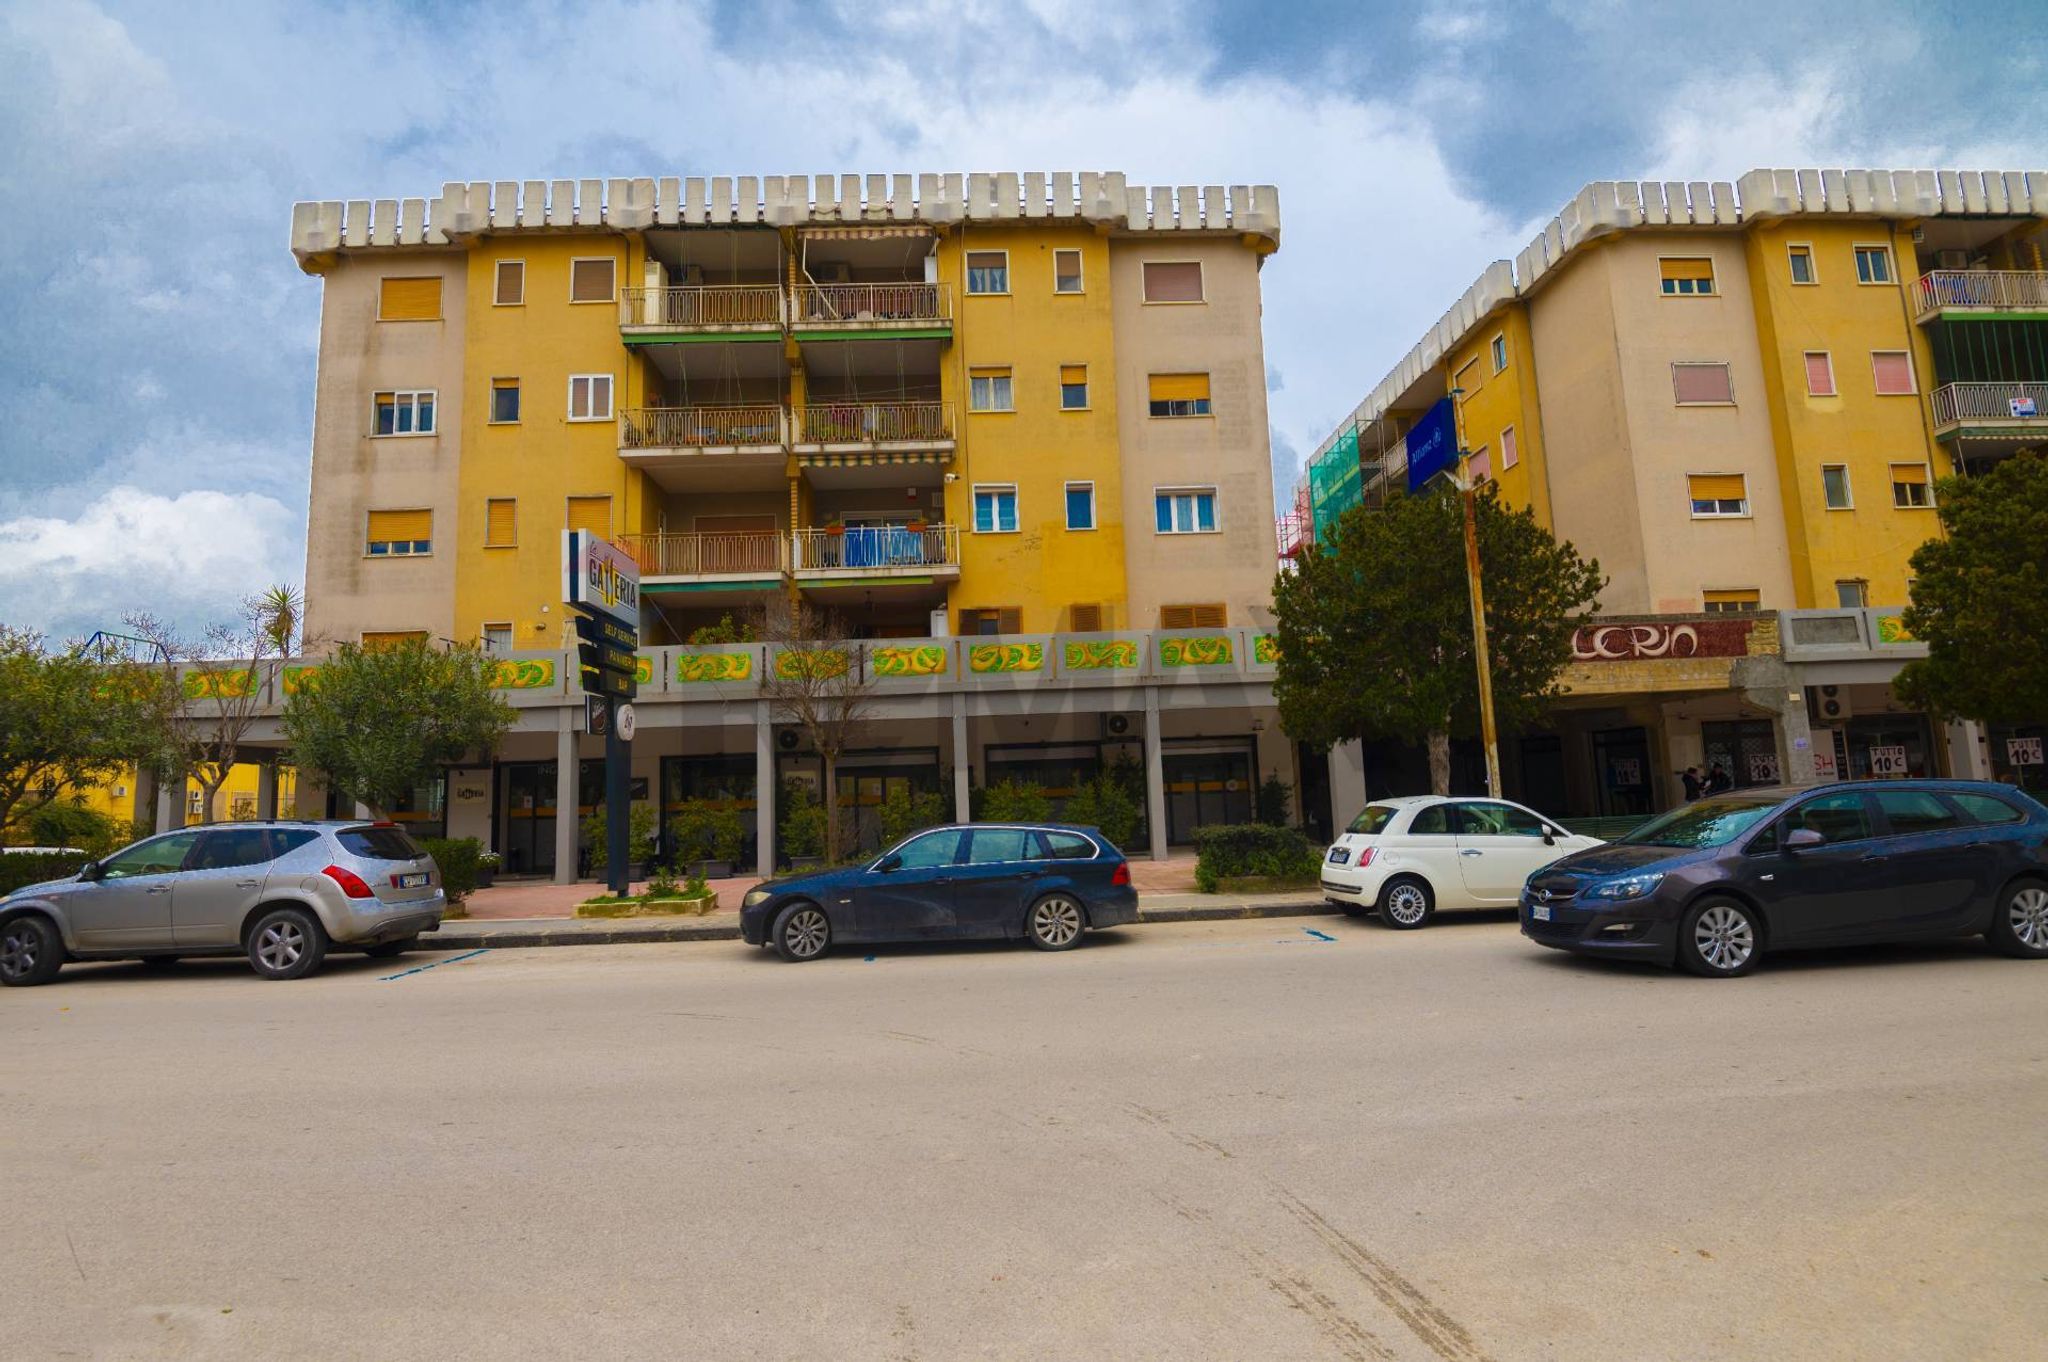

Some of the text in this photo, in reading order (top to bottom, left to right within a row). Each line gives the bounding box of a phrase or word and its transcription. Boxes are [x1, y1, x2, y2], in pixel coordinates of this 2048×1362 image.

[1871, 747, 1903, 756] TUTTO
[2011, 749, 2030, 764] 10
[1874, 757, 1892, 772] 10
